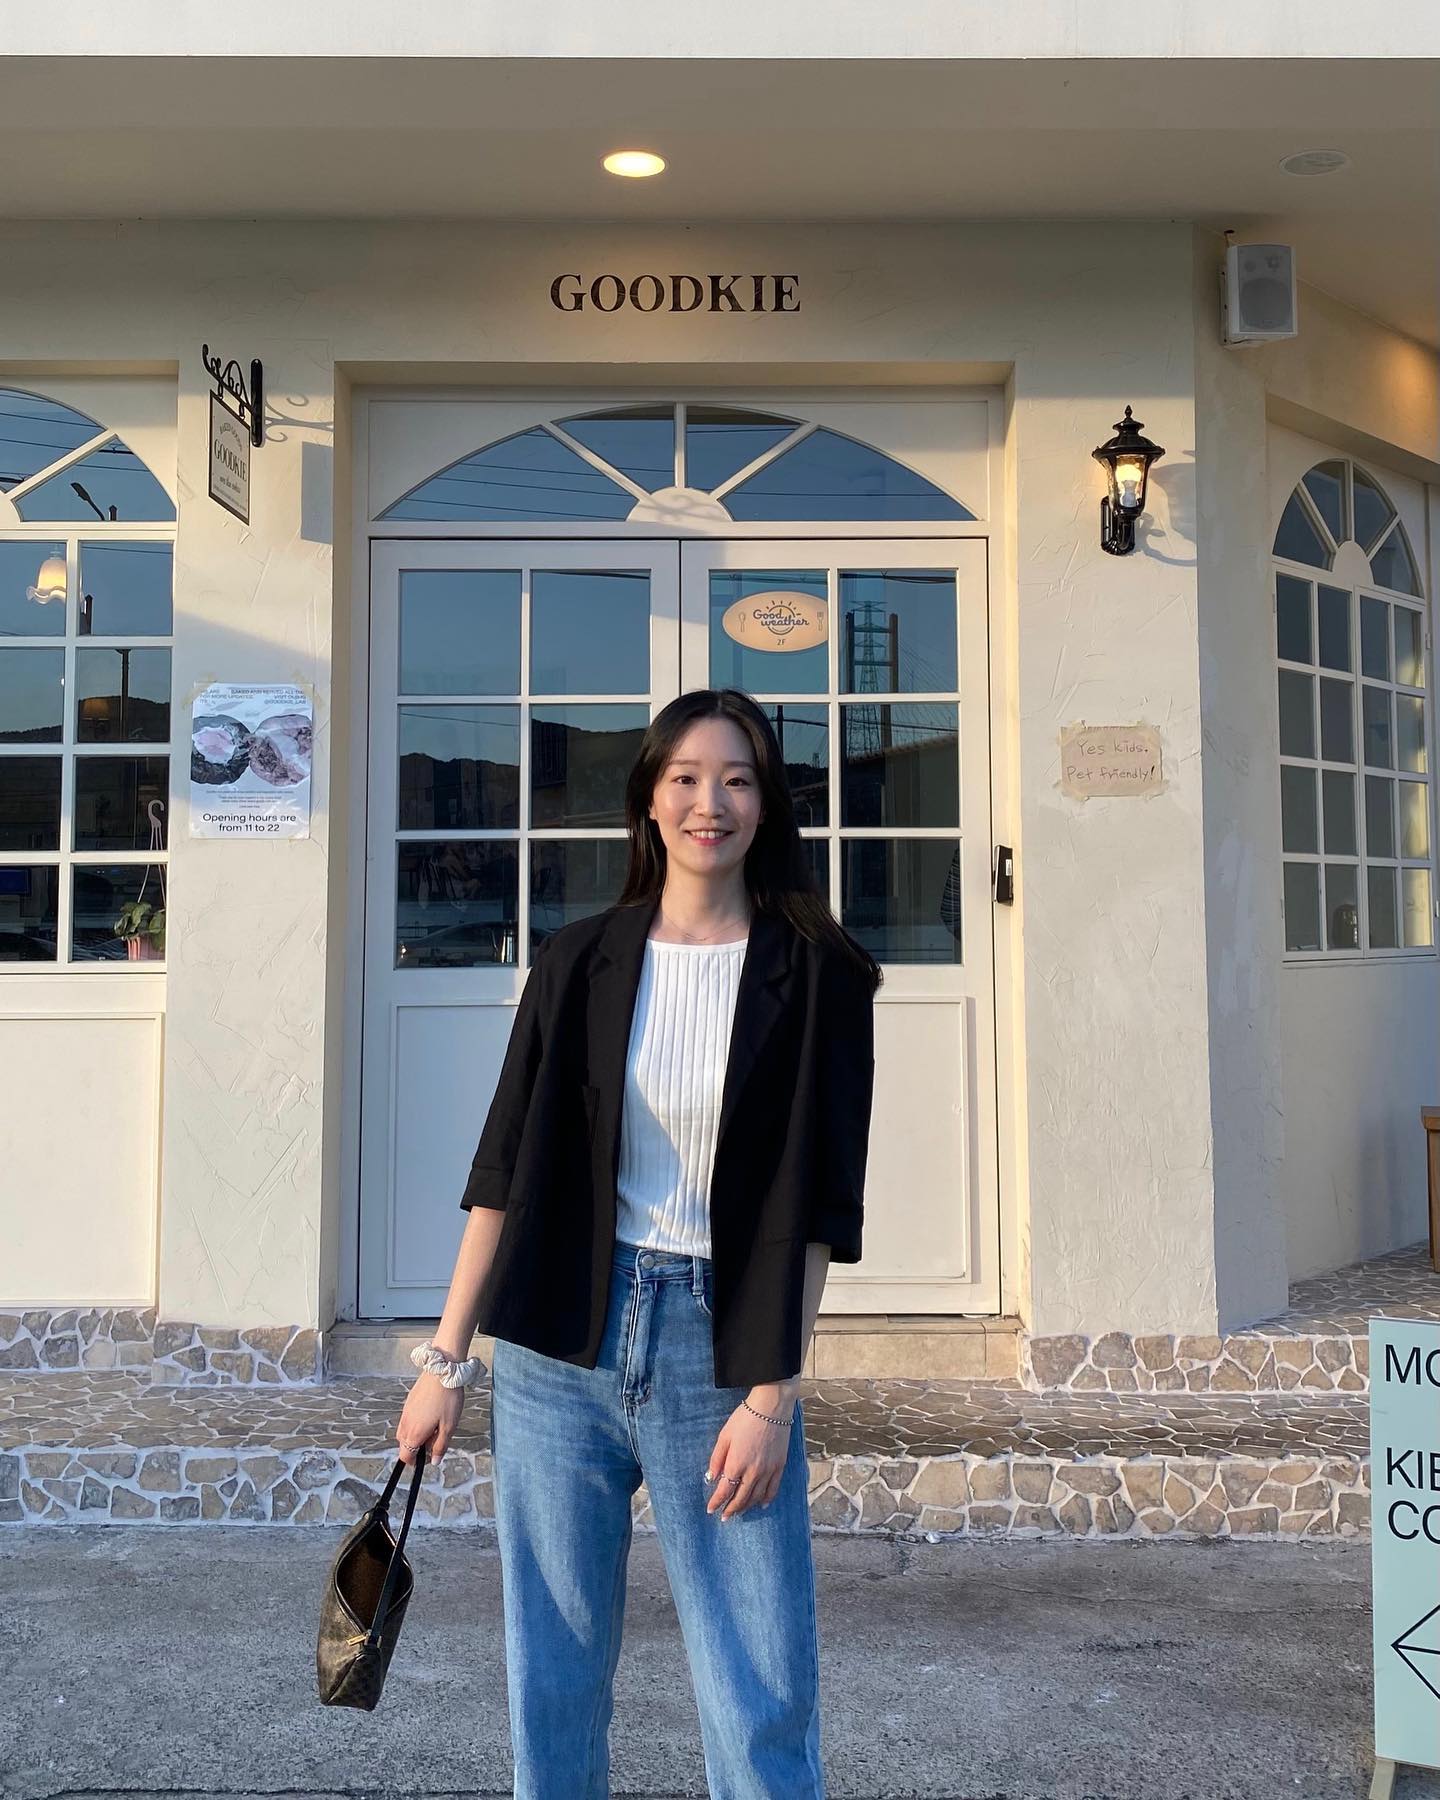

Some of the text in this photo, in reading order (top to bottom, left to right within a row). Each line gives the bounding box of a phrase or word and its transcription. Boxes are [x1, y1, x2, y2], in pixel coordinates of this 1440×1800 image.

[550, 274, 801, 312] GOODKIE
[214, 438, 247, 482] GOODKIE
[753, 608, 784, 620] Good
[761, 615, 809, 627] weather
[1077, 739, 1105, 756] Yes
[1066, 765, 1155, 782] Pet friendly!
[202, 812, 297, 824] Opening hours are
[219, 823, 280, 832] from 11 to 22
